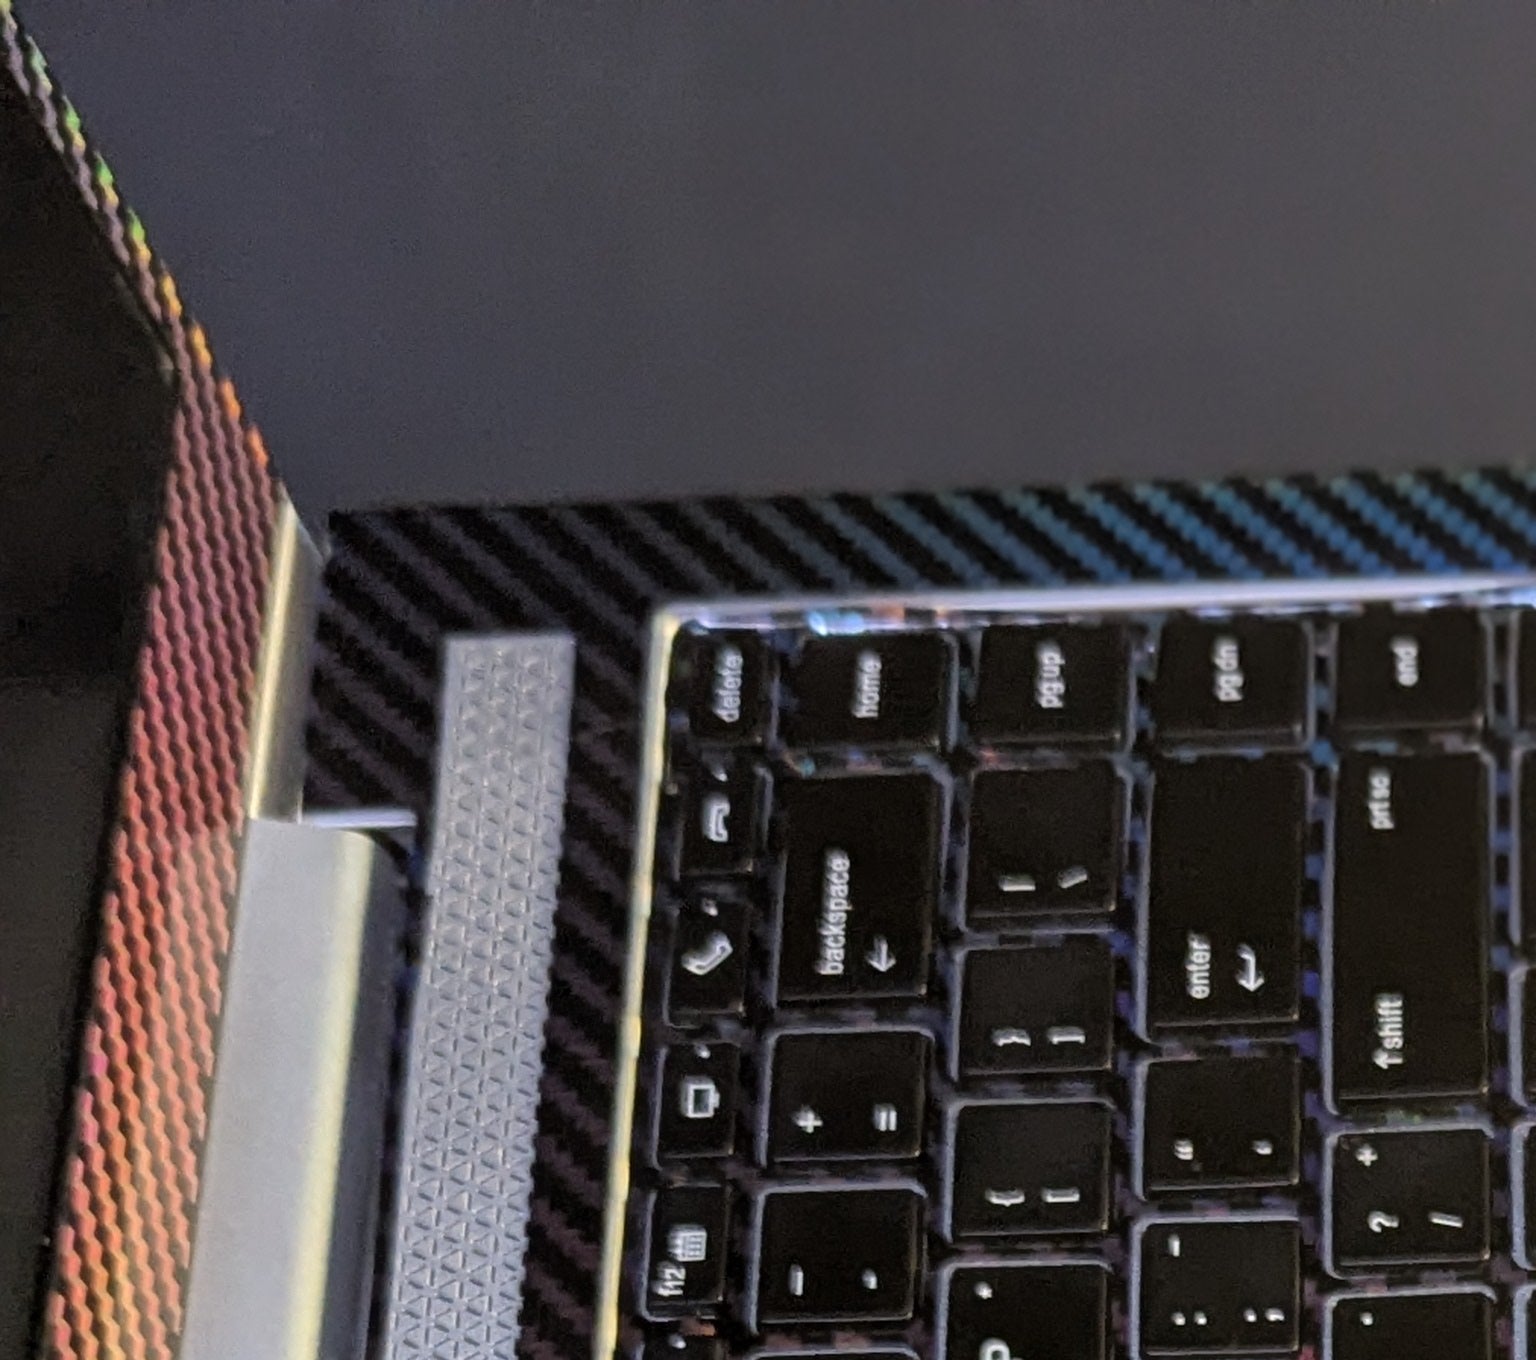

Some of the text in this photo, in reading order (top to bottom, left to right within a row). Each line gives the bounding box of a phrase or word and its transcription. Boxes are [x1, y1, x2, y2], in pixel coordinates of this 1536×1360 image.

[712, 647, 744, 723] delete
[852, 652, 882, 719] home
[1036, 640, 1066, 709] pg up
[1214, 637, 1242, 701] pg dn
[1391, 638, 1419, 687] end
[817, 851, 853, 976] backspace
[1185, 934, 1211, 1000] enter
[1377, 992, 1405, 1050] shift
[655, 1265, 686, 1297] f12
